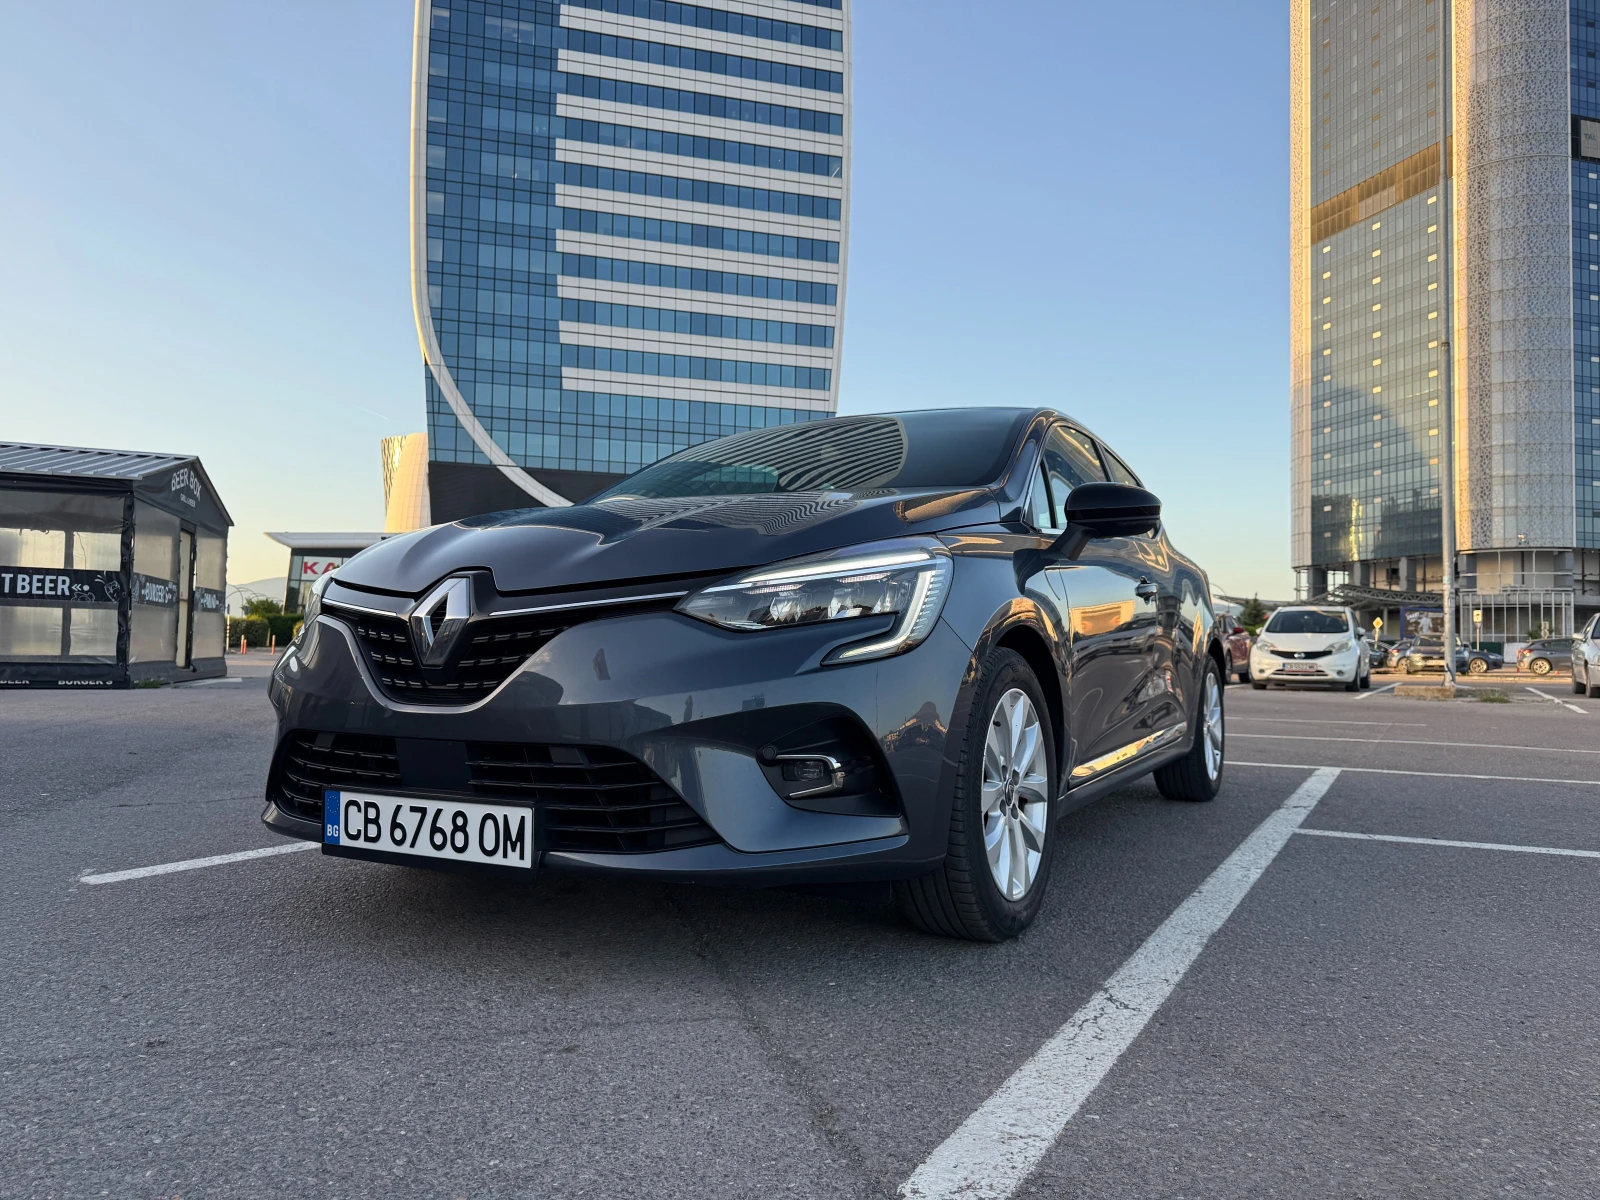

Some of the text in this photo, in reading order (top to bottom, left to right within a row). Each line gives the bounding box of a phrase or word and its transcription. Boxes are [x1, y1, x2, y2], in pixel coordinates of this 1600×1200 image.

[171, 467, 202, 501] BEER BOX
[16, 573, 71, 596] BEER
[326, 823, 339, 837] BG
[344, 799, 526, 861] CB 6768 OM
